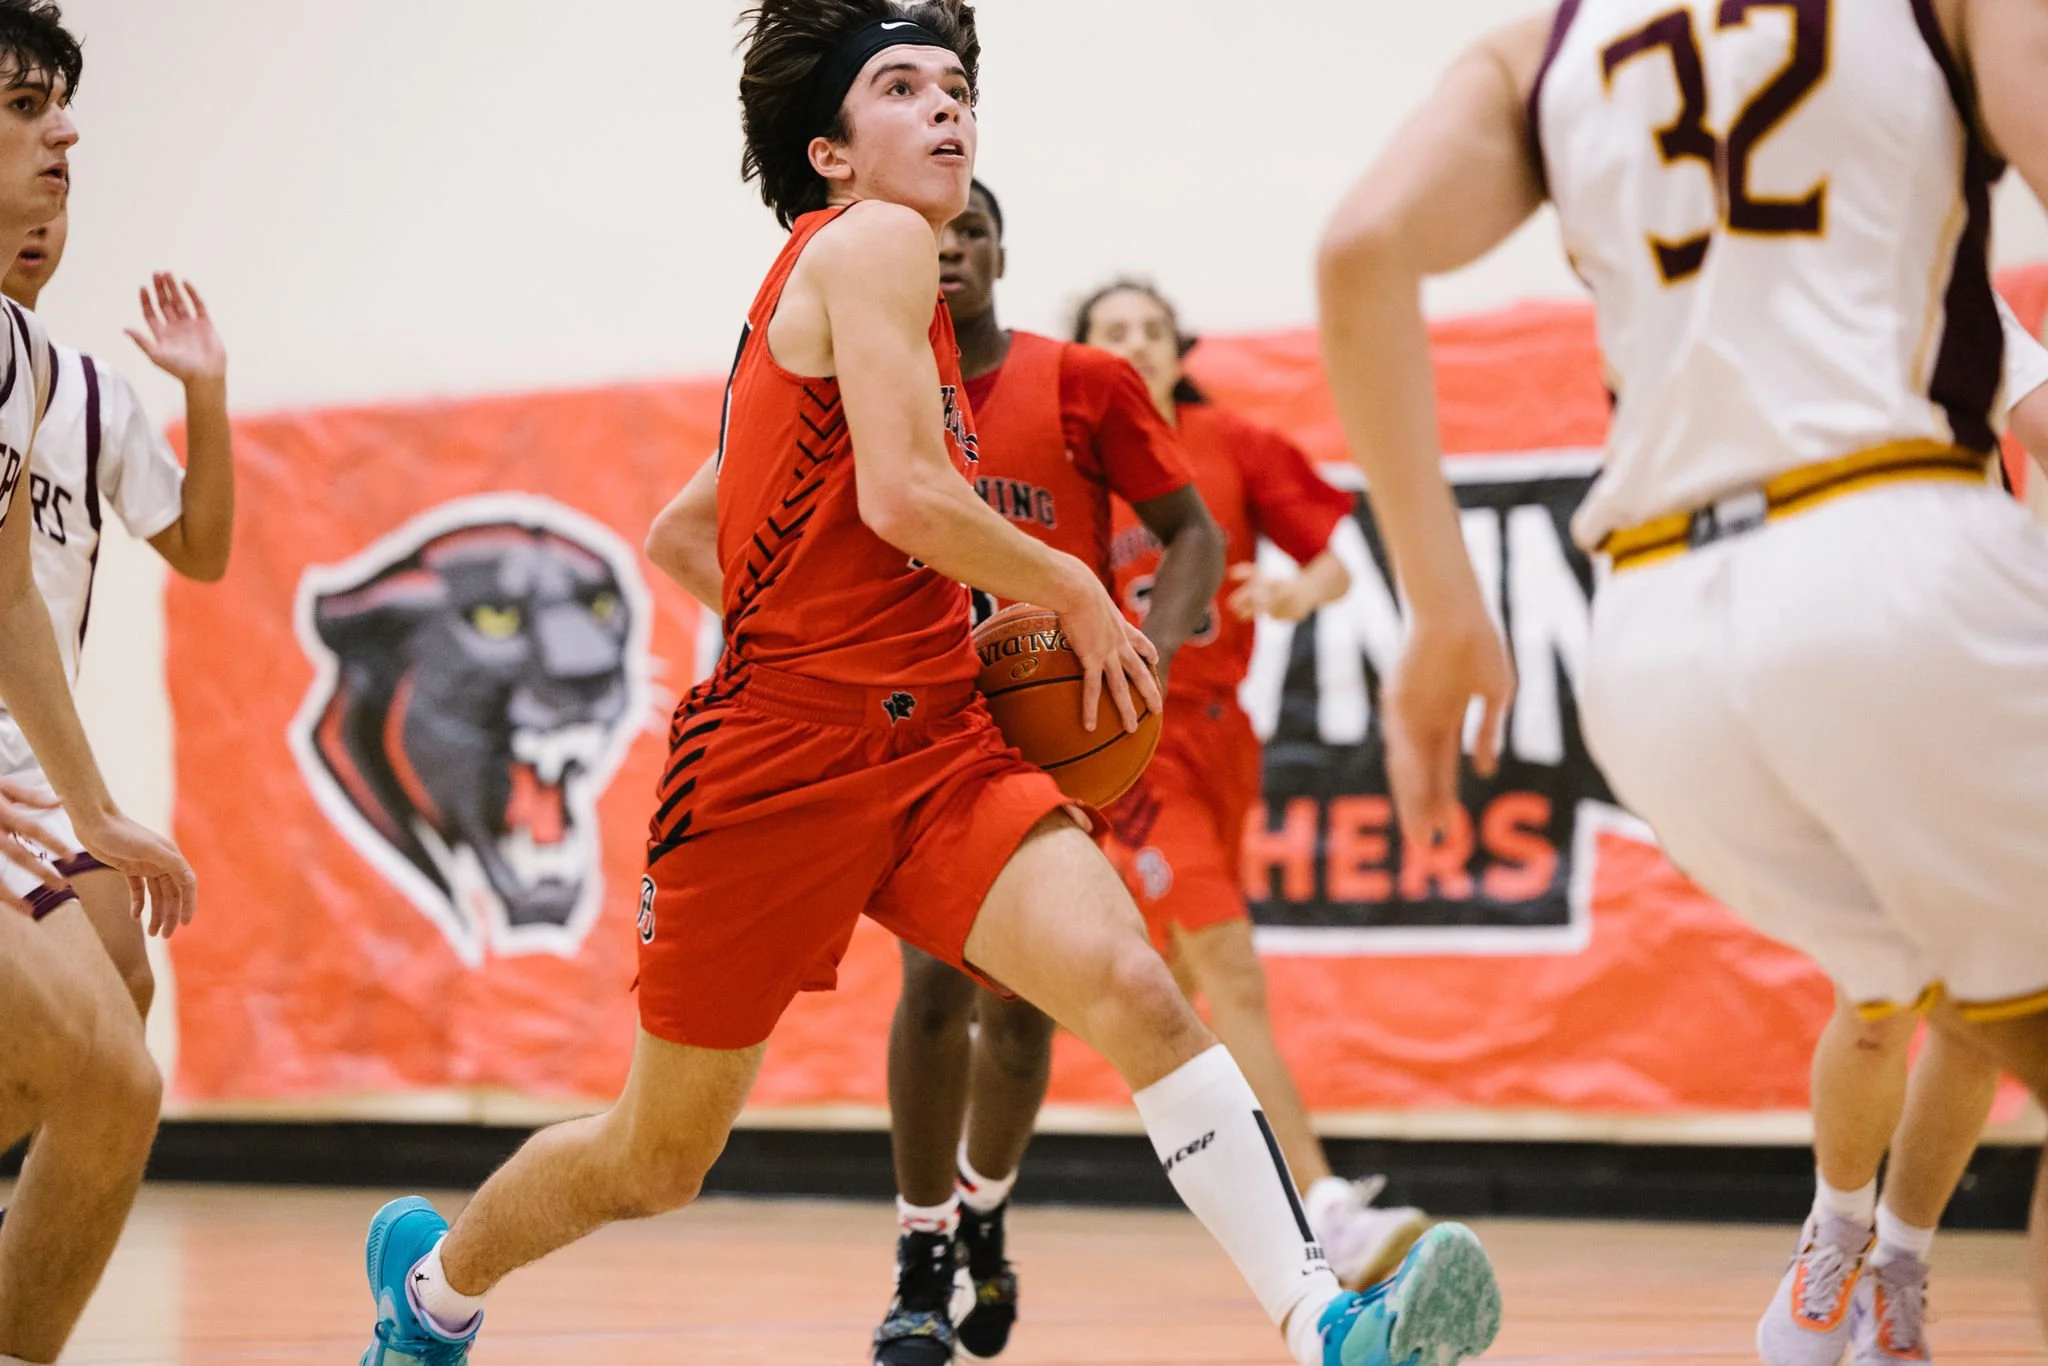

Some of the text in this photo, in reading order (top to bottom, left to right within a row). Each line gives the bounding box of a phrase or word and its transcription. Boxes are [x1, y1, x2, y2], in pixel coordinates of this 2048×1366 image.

[1598, 0, 1833, 287] 32
[1241, 790, 1558, 903] HERS
[1175, 1129, 1216, 1163] cep
